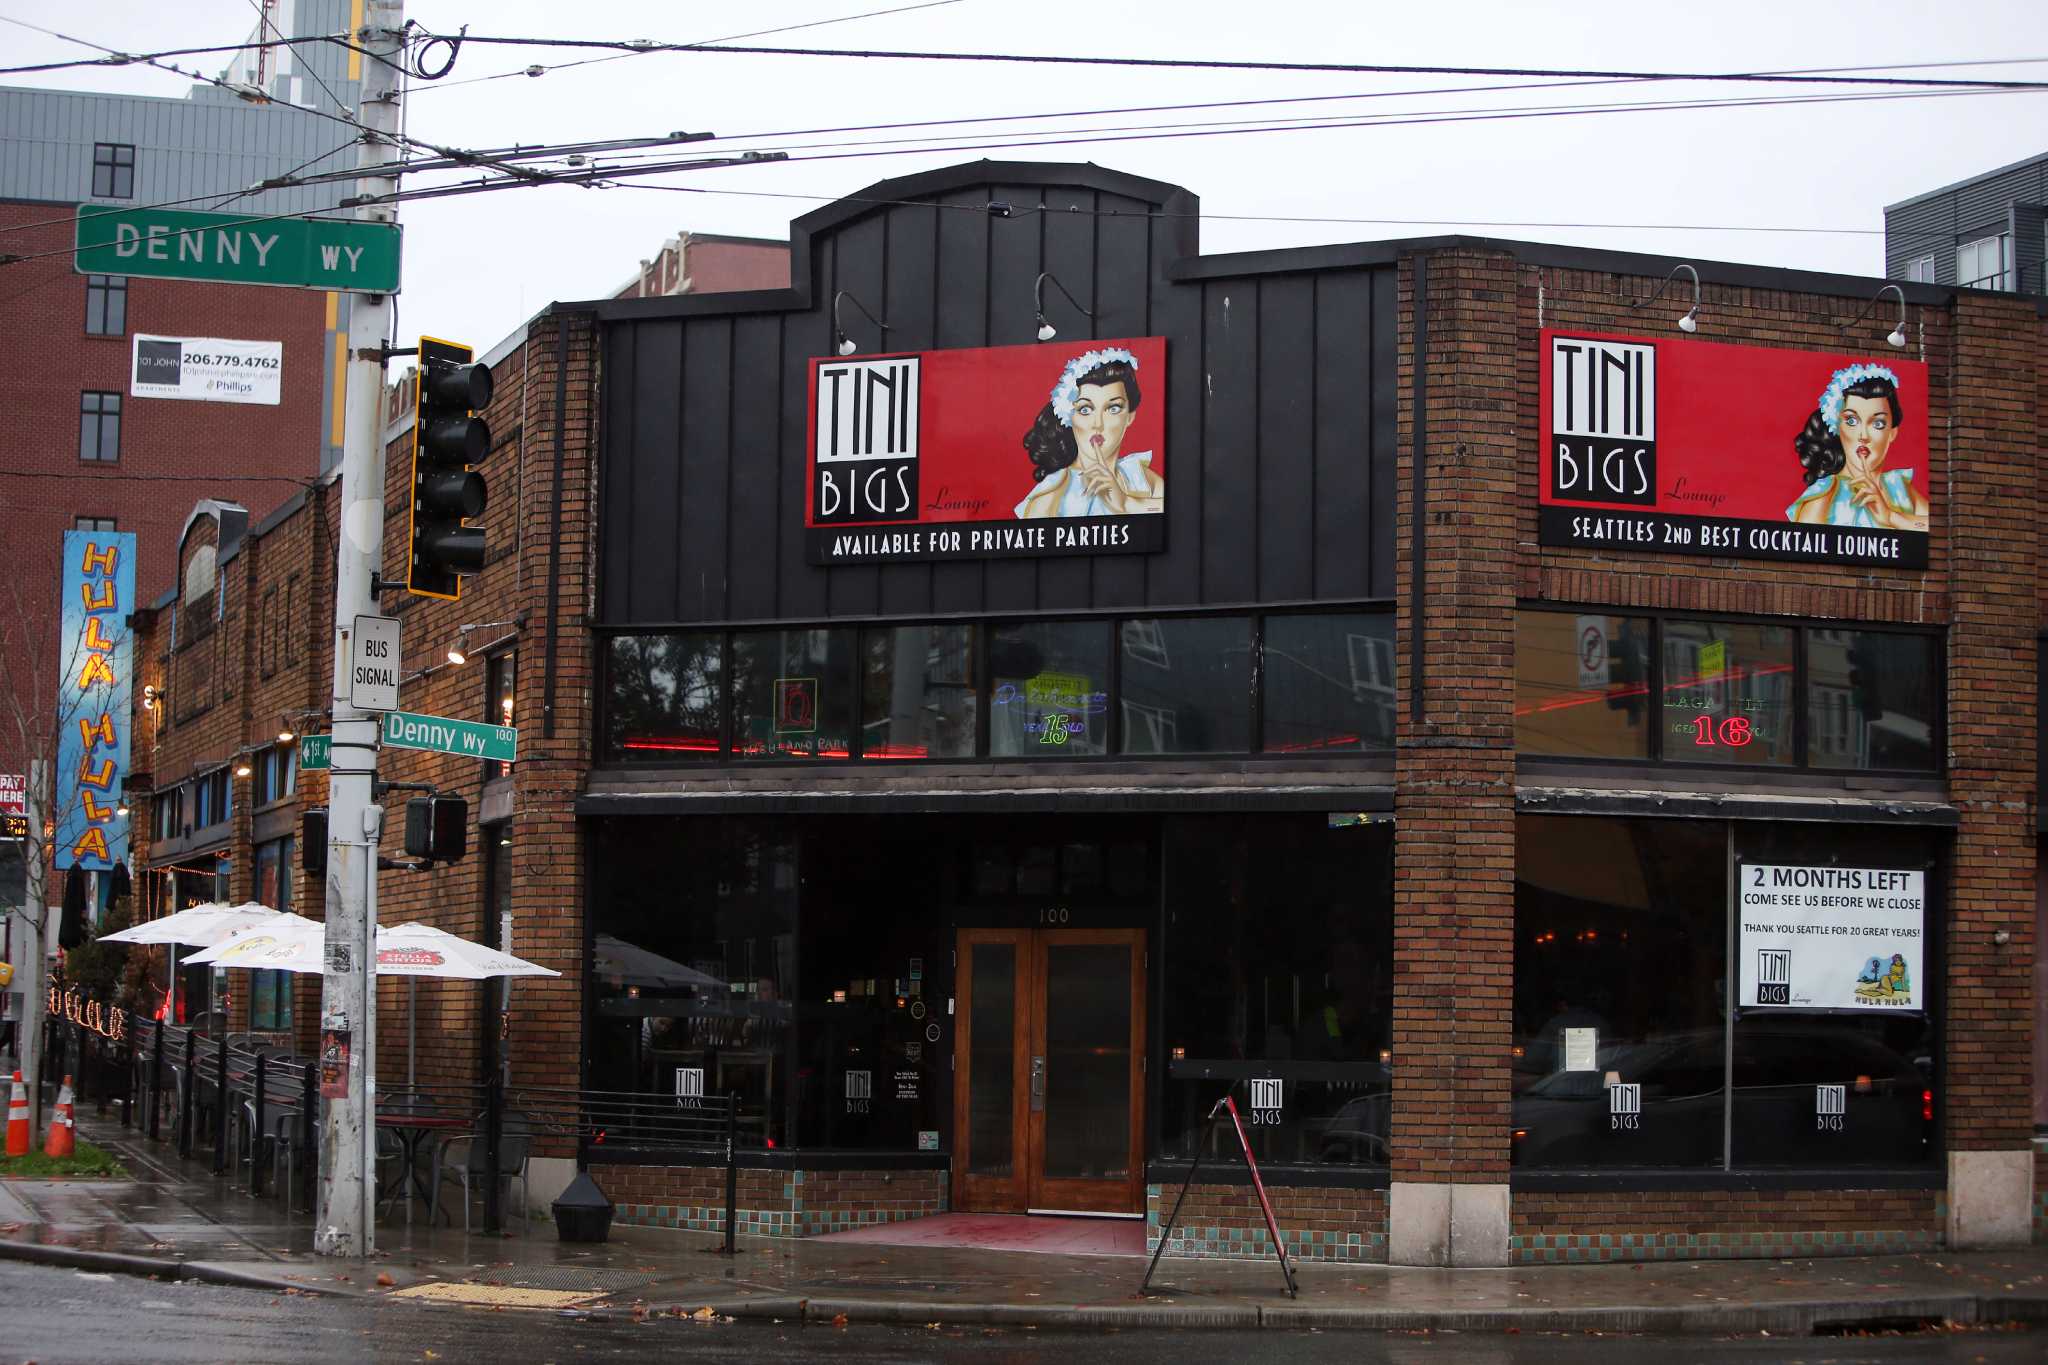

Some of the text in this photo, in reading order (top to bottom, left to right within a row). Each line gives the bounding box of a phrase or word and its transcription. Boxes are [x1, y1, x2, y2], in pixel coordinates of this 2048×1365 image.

[116, 223, 364, 272] DENNY WY
[139, 357, 179, 368] 101 JOHN
[183, 353, 279, 369] 206.779.4762
[216, 380, 253, 393] Phillips
[1557, 345, 1643, 436] TINI
[824, 365, 909, 456] TINI
[1559, 443, 1648, 495] BIGS
[821, 466, 910, 516] BIGS
[927, 485, 990, 514] Lounge
[1664, 477, 1726, 508] Lounge
[832, 524, 1129, 556] AVAILABLE FOR PRIVATE PARTIES
[1572, 516, 1900, 559] SEATTLES 2ND BEST COCKTAIL LOUNGE
[365, 639, 388, 658] BUS
[355, 667, 395, 687] SIGNAL
[72, 542, 119, 861] HULA HULA
[389, 715, 513, 755] Denny Wy 100
[1040, 714, 1069, 744] 15
[1693, 715, 1753, 746] 16
[311, 740, 320, 765] 1st
[0, 777, 20, 790] PAY
[1753, 867, 1910, 891] 2 MONTHS LEFT
[1744, 893, 1921, 910] COME SEE US BEFORE WE CLOSE
[1040, 907, 1069, 923] 100
[1744, 924, 1920, 937] THANK YOU SEATTLE FOR 20 GREAT YEARS!
[1761, 953, 1787, 982] TINI
[1760, 986, 1786, 1002] BIGS
[677, 1070, 700, 1096] TINI
[847, 1072, 869, 1096] TINI
[1252, 1080, 1280, 1108] TINI
[846, 1100, 870, 1113] BIGS
[1611, 1085, 1637, 1112] TINI
[1818, 1087, 1842, 1112] TINI
[1252, 1110, 1281, 1125] BIGS
[1611, 1114, 1639, 1129] BIGS
[1817, 1115, 1843, 1130] BIGS
